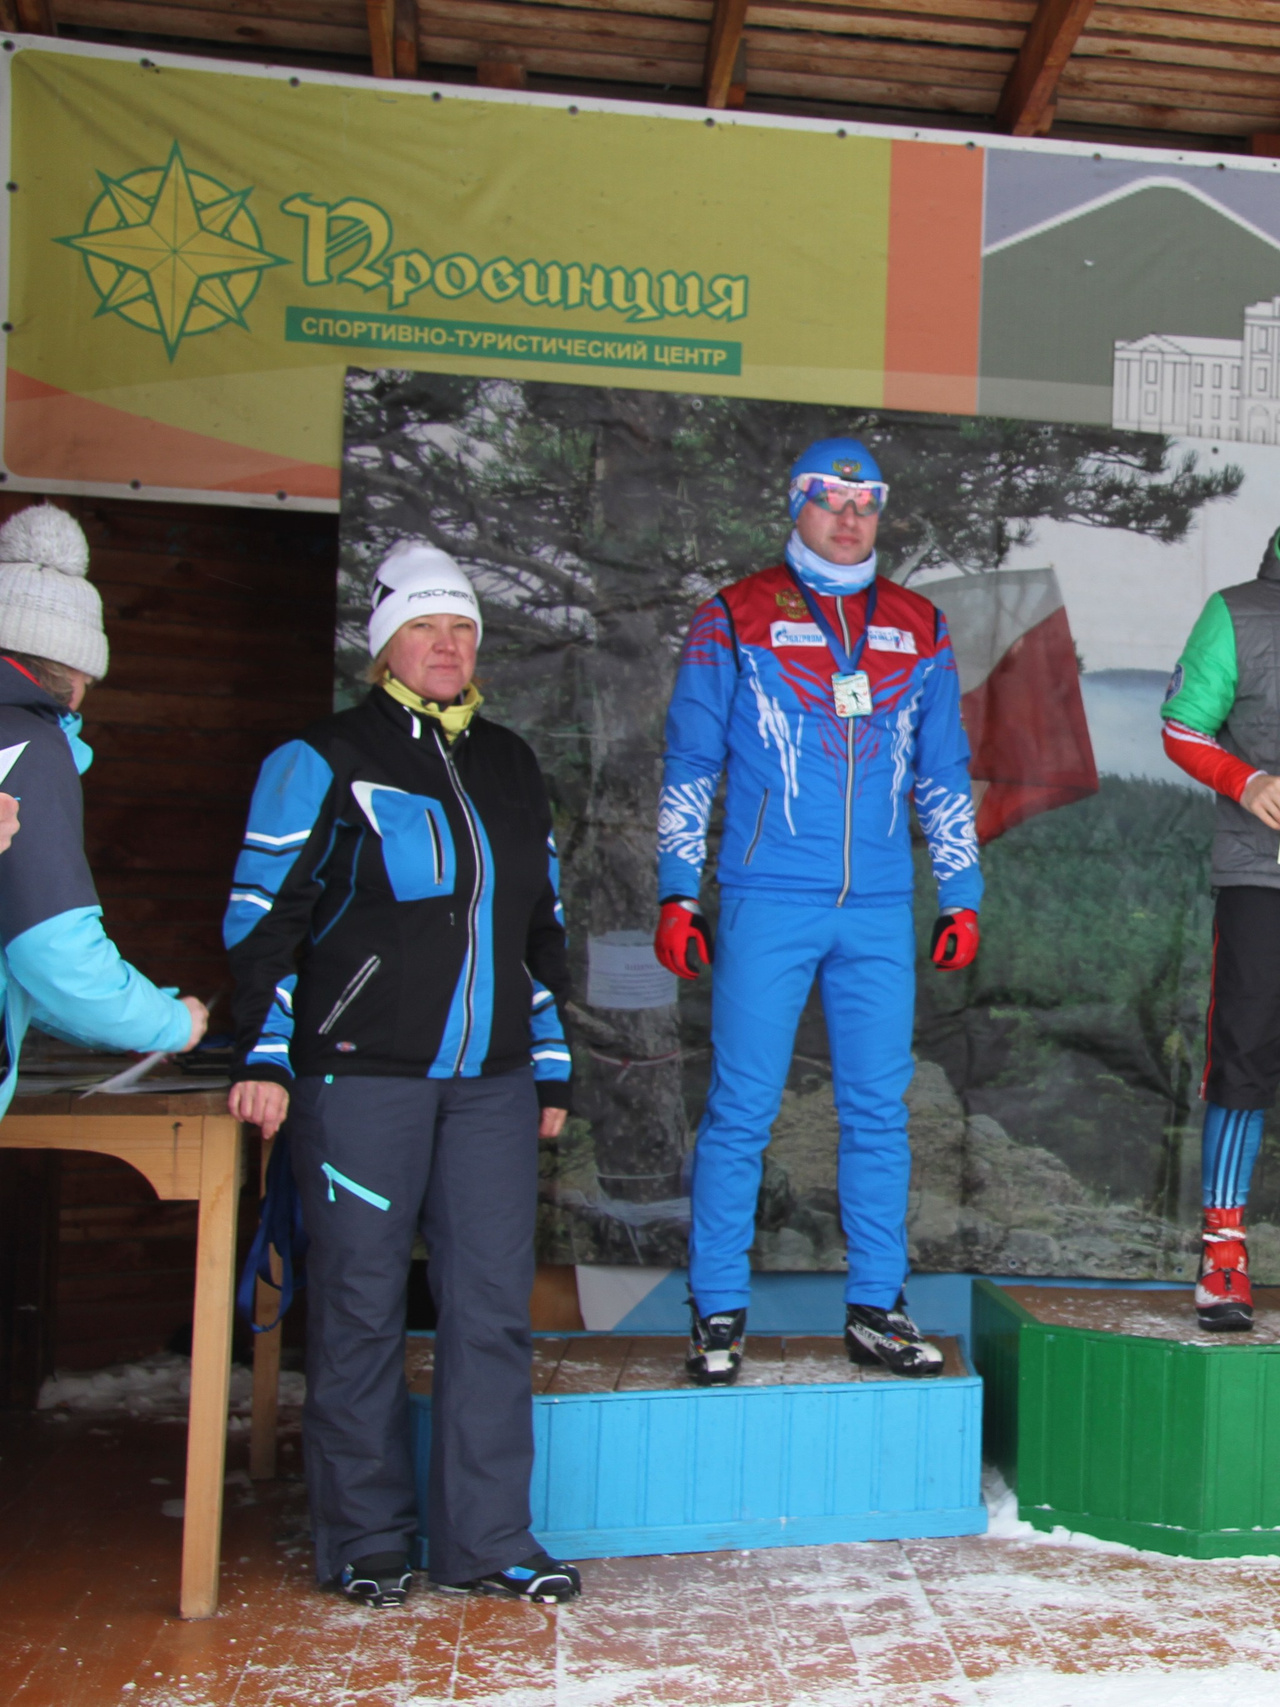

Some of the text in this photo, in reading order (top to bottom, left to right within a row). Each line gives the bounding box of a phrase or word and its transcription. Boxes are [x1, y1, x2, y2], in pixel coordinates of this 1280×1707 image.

[280, 192, 748, 322] Провинция
[301, 315, 728, 367] СПОРТИВНО-ТУРИСТИЧЕСКИЙ ЦЕНТР
